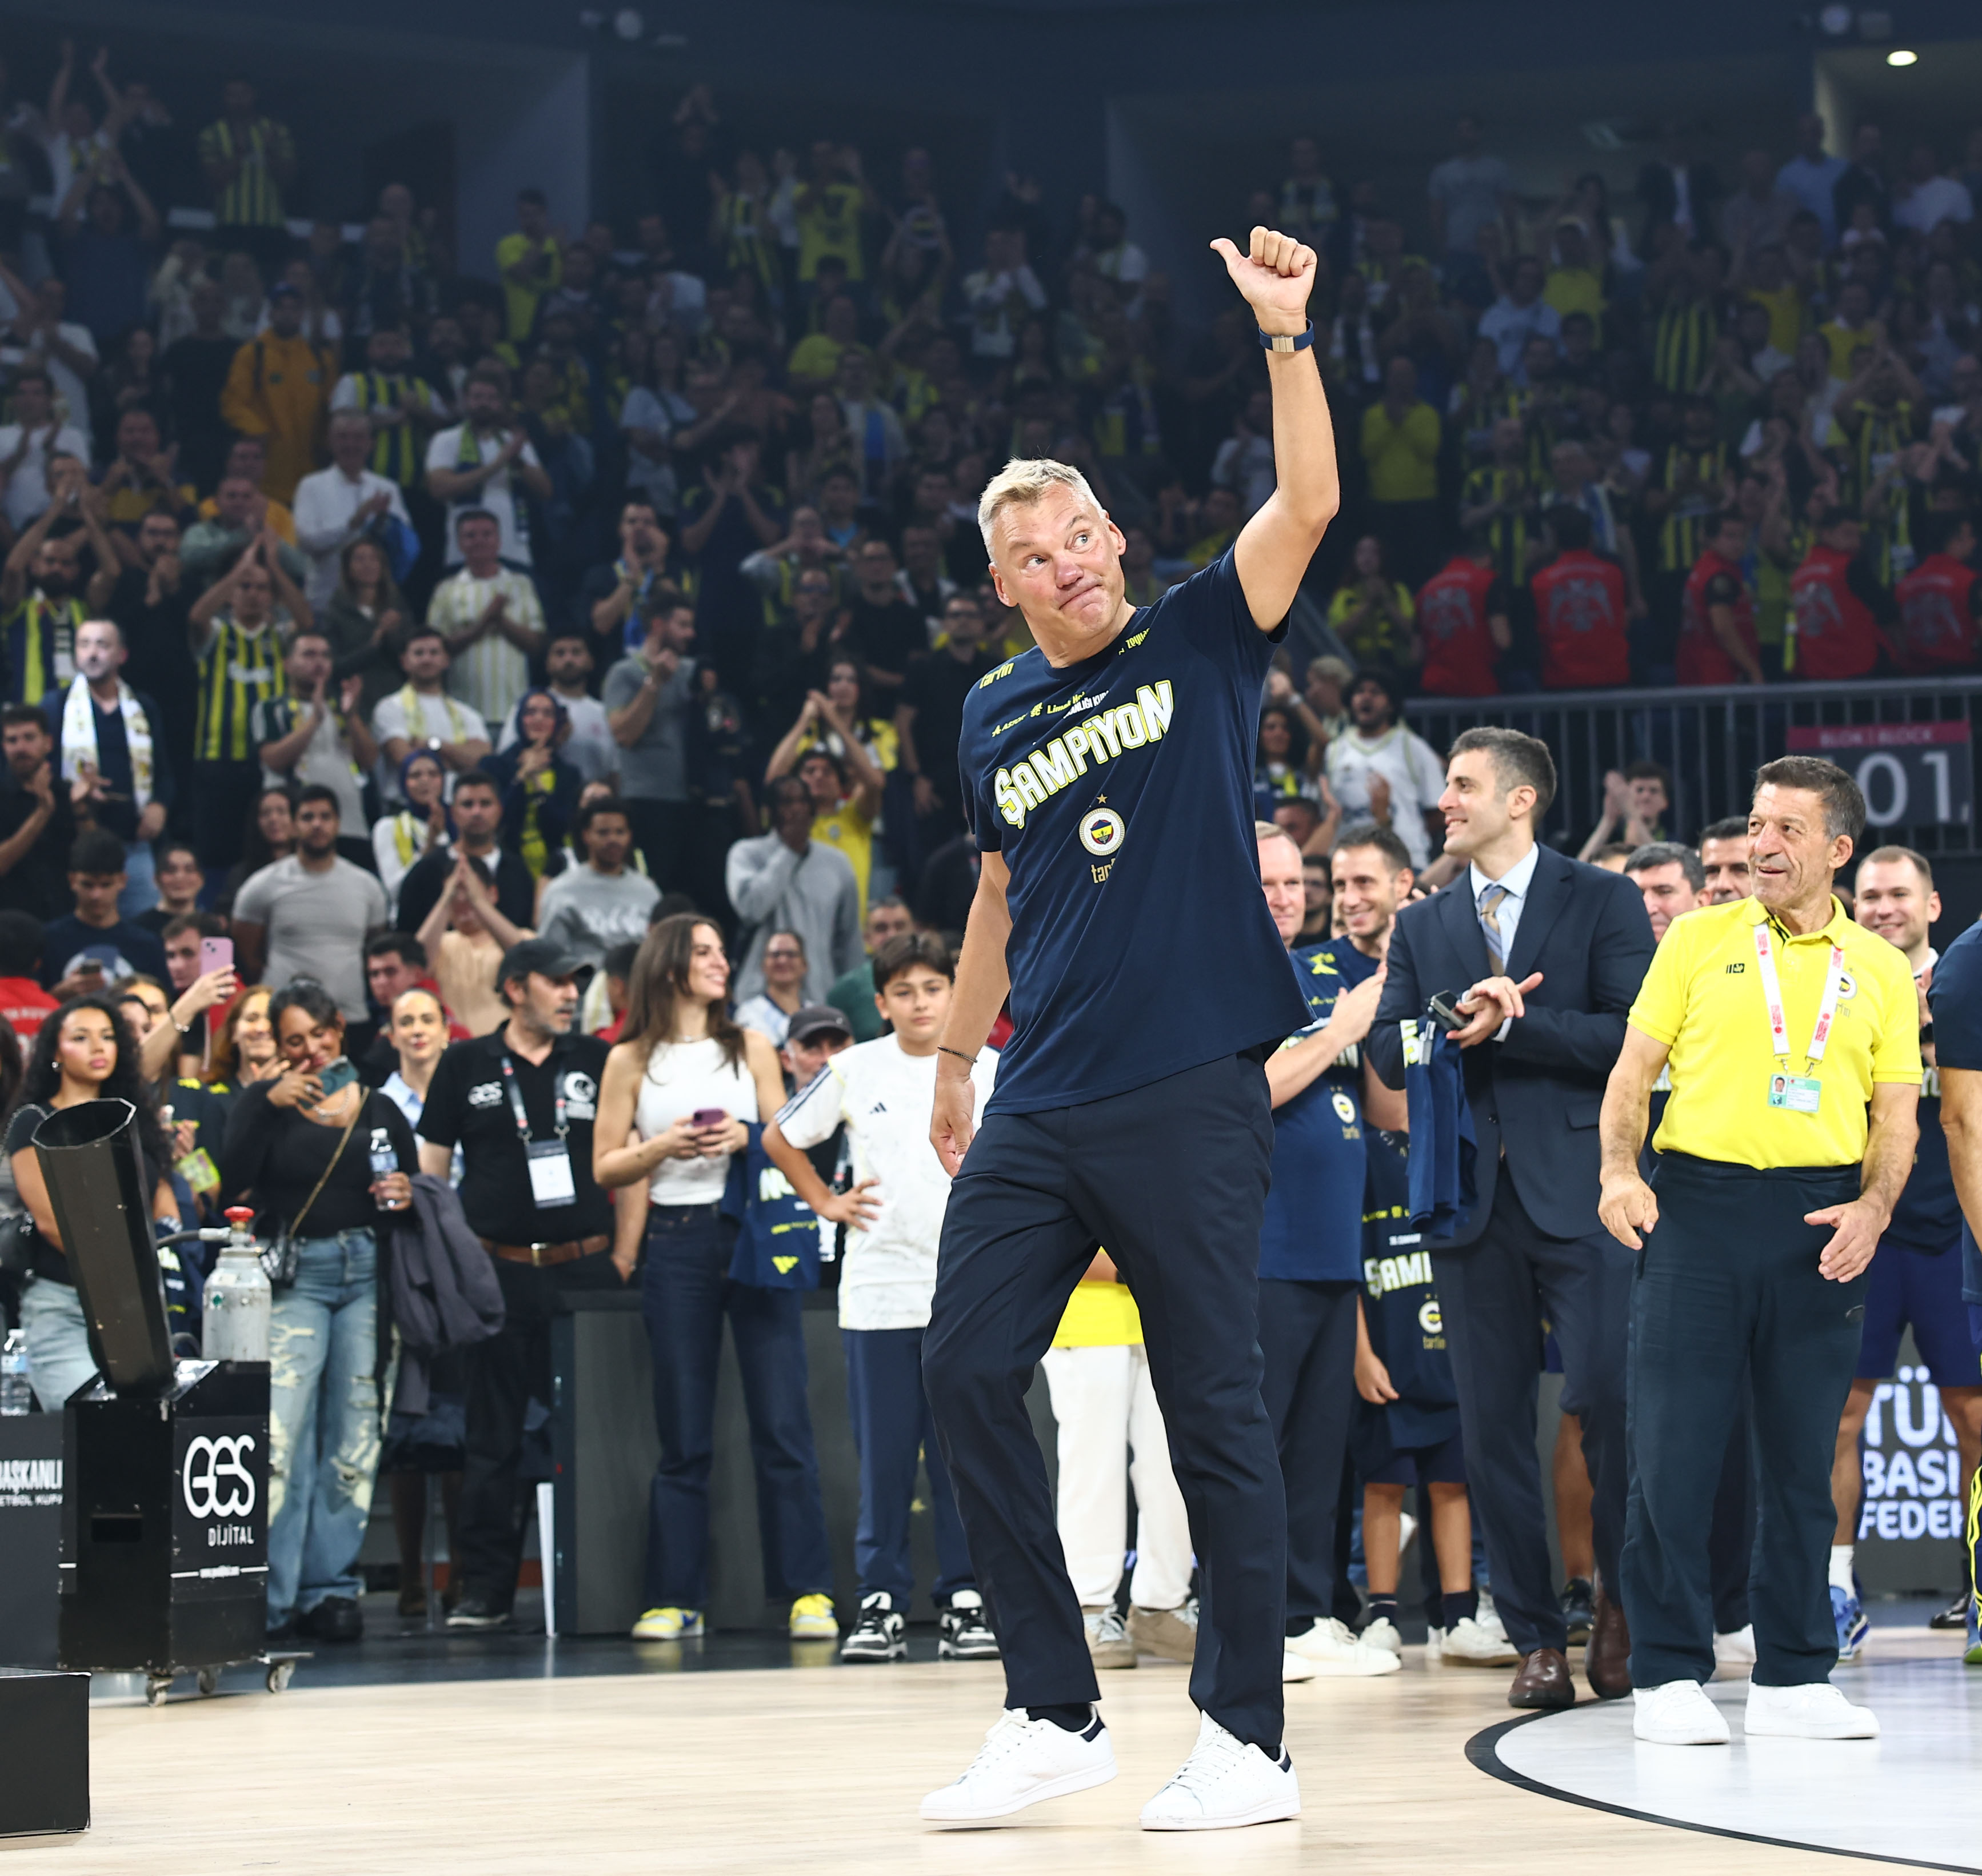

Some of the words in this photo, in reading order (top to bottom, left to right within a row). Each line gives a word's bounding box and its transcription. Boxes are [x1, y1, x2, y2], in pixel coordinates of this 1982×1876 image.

[979, 662, 1014, 689] tarfin
[1064, 696, 1093, 719] ANLIĞI
[1823, 751, 1950, 827] 01
[0, 1459, 63, 1495] AŞKANLI
[207, 1523, 255, 1547] DİJİTAL
